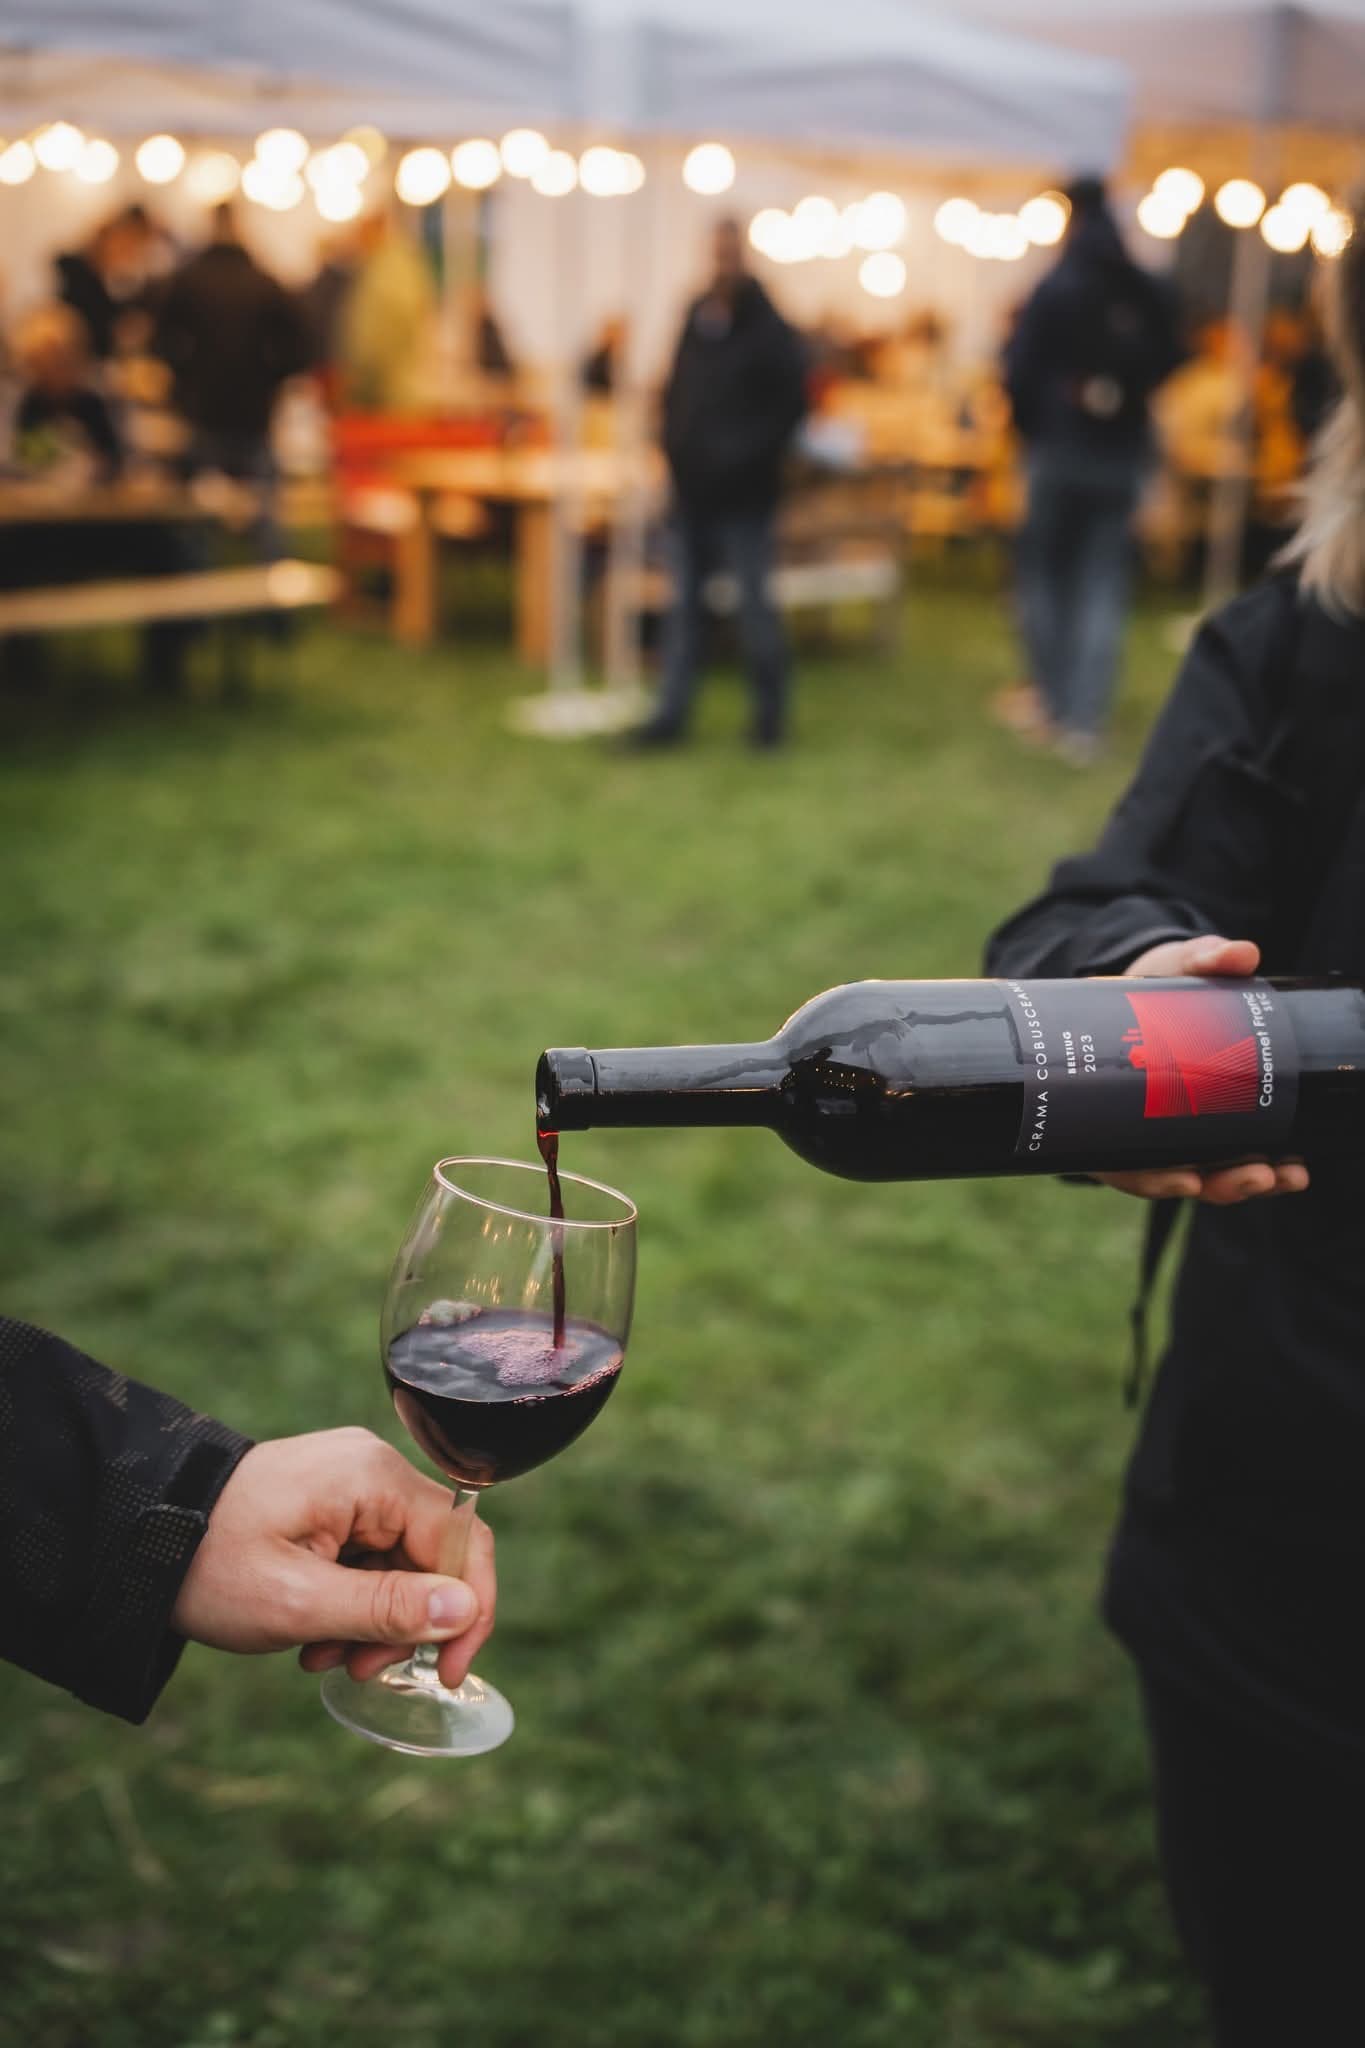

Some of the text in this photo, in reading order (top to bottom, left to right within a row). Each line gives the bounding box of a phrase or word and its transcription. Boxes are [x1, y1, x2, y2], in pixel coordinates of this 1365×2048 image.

[1062, 1031, 1077, 1075] BELTIUG
[1081, 1034, 1097, 1073] 2023
[1243, 991, 1274, 1107] Cabernet Franc
[1029, 1091, 1048, 1151] CRAMA
